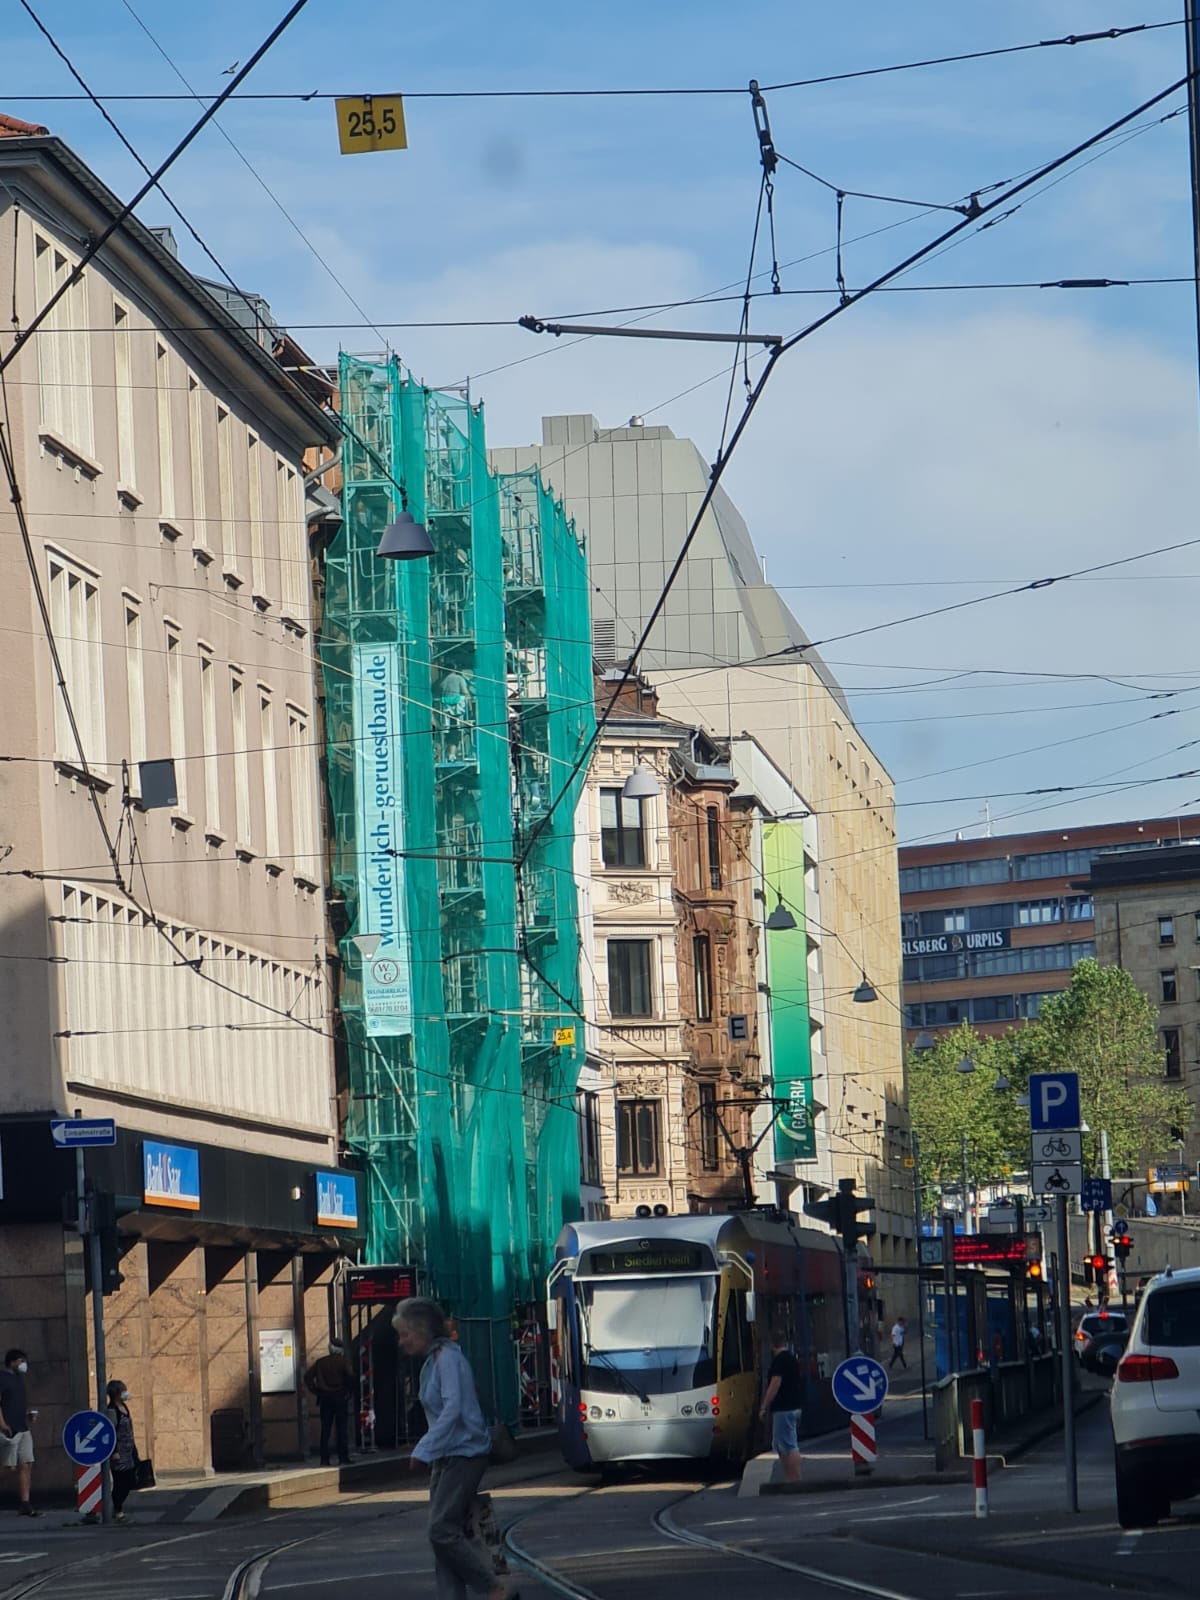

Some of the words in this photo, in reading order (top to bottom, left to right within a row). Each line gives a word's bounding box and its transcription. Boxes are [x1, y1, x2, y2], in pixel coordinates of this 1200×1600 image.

[348, 108, 397, 140] 25,5
[966, 932, 1003, 948] URPILS
[731, 1017, 746, 1039] E
[1041, 1080, 1067, 1123] P
